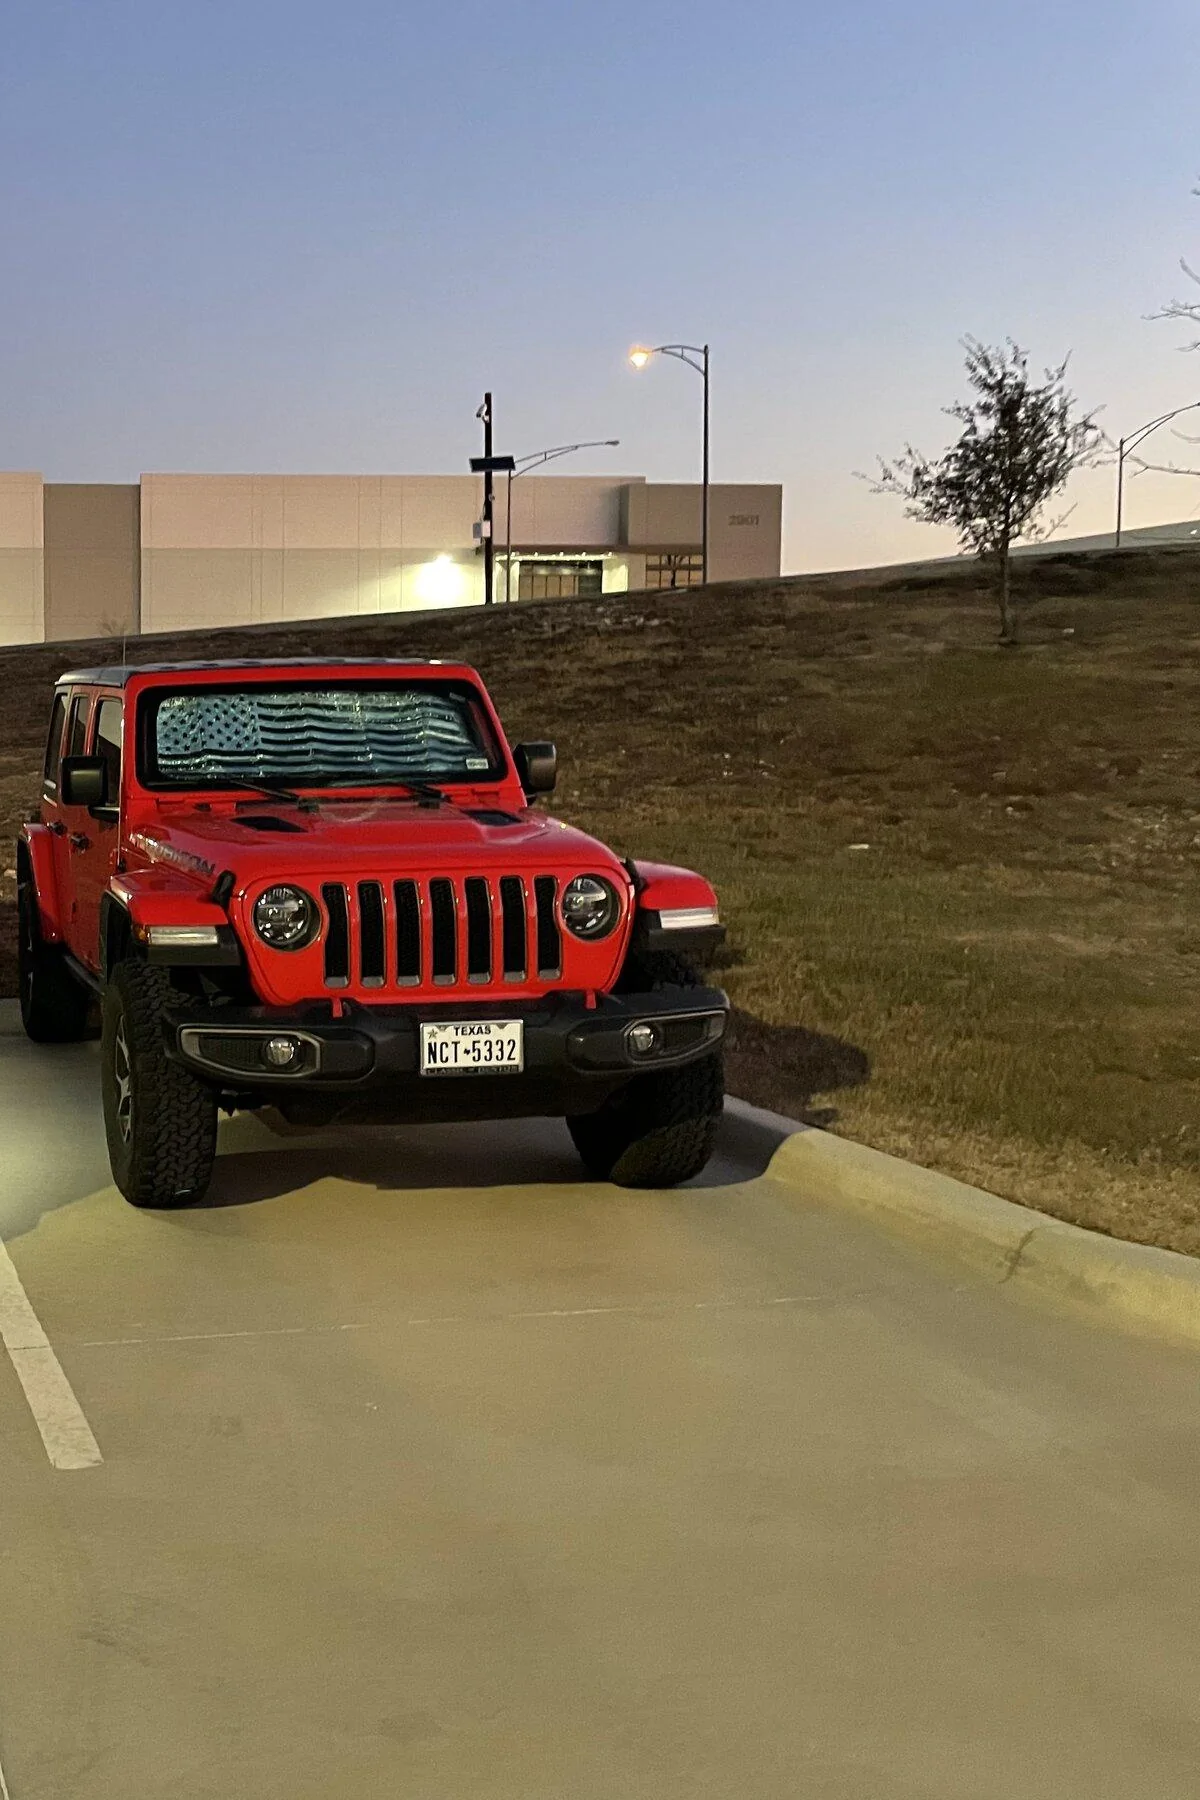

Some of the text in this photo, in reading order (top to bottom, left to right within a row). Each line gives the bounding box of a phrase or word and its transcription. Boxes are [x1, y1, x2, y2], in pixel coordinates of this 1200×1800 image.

[453, 1025, 492, 1036] TEXAS
[427, 1038, 516, 1064] NCT 5332
